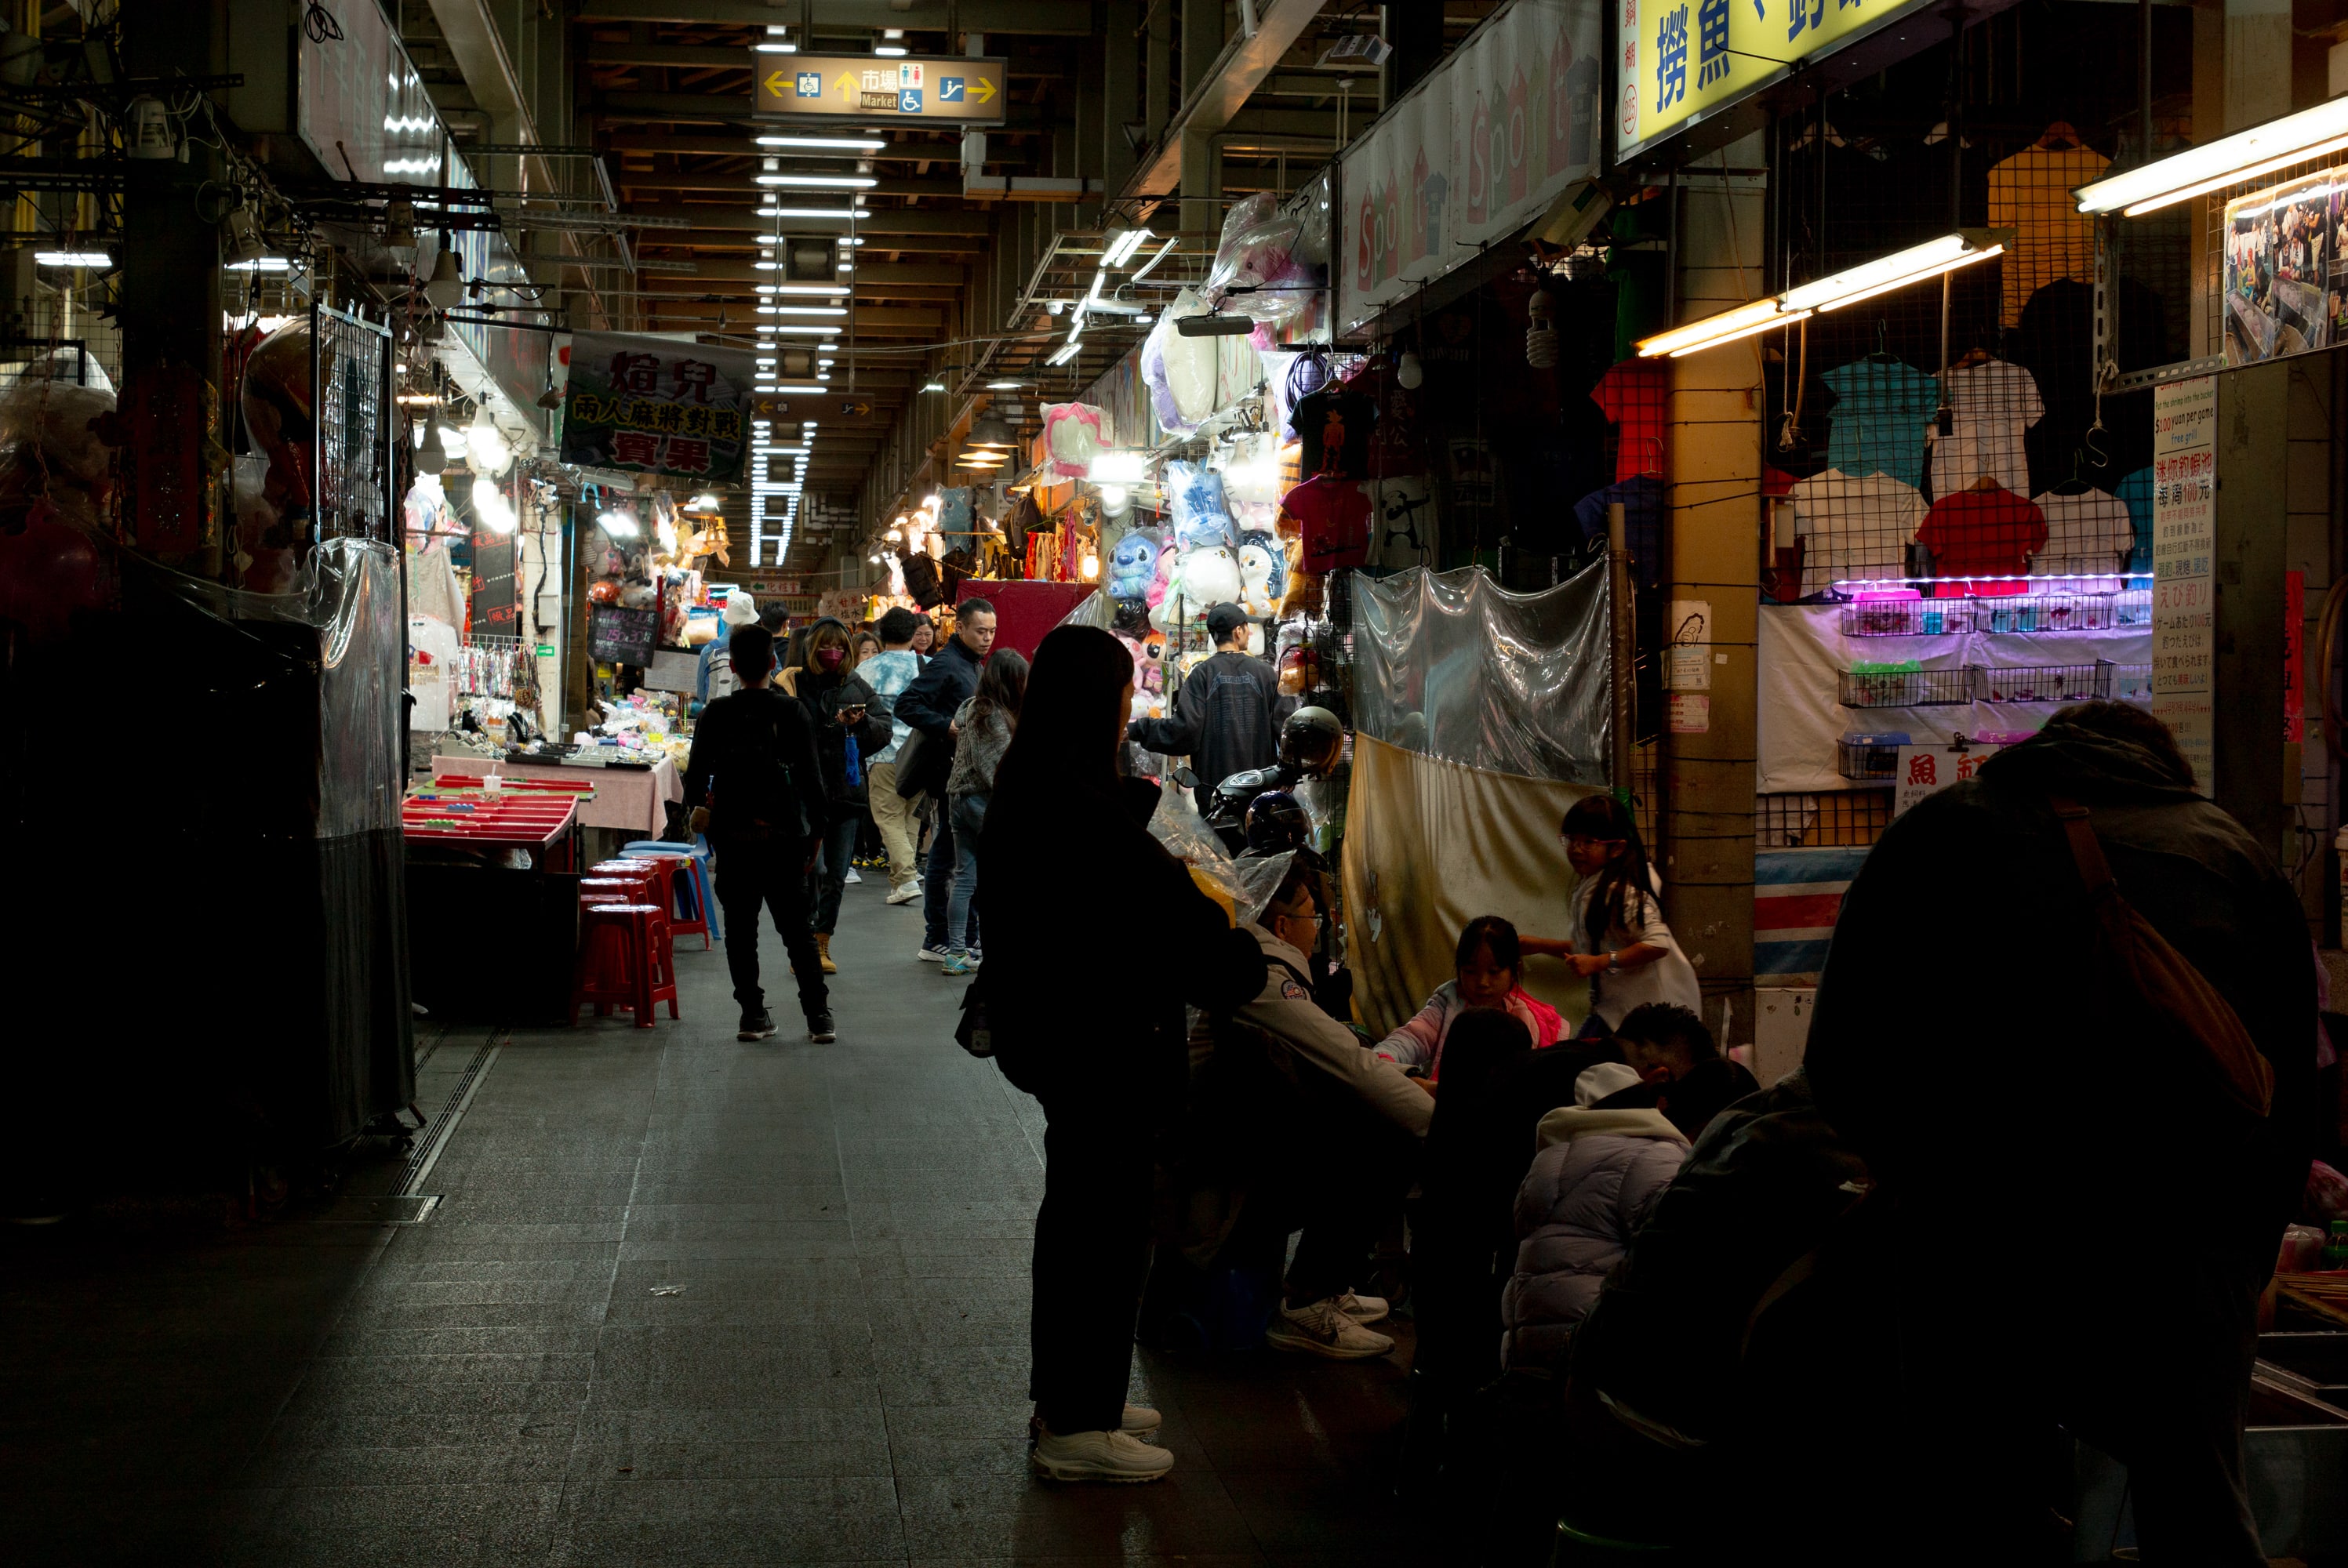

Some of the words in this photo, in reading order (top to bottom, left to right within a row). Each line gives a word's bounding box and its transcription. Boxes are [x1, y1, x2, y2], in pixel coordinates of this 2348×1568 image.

[862, 69, 897, 92] 市場
[862, 93, 897, 108] Market
[1624, 96, 1635, 124] 225
[572, 394, 741, 441] 兩人麻將對戰
[2186, 410, 2197, 426] per
[2198, 407, 2214, 425] game
[2172, 433, 2183, 445] free
[2185, 428, 2197, 445] grill
[609, 430, 713, 473] 賓果
[2157, 451, 2212, 482] 迷你釣蝦池
[2160, 583, 2208, 608] えび釣り
